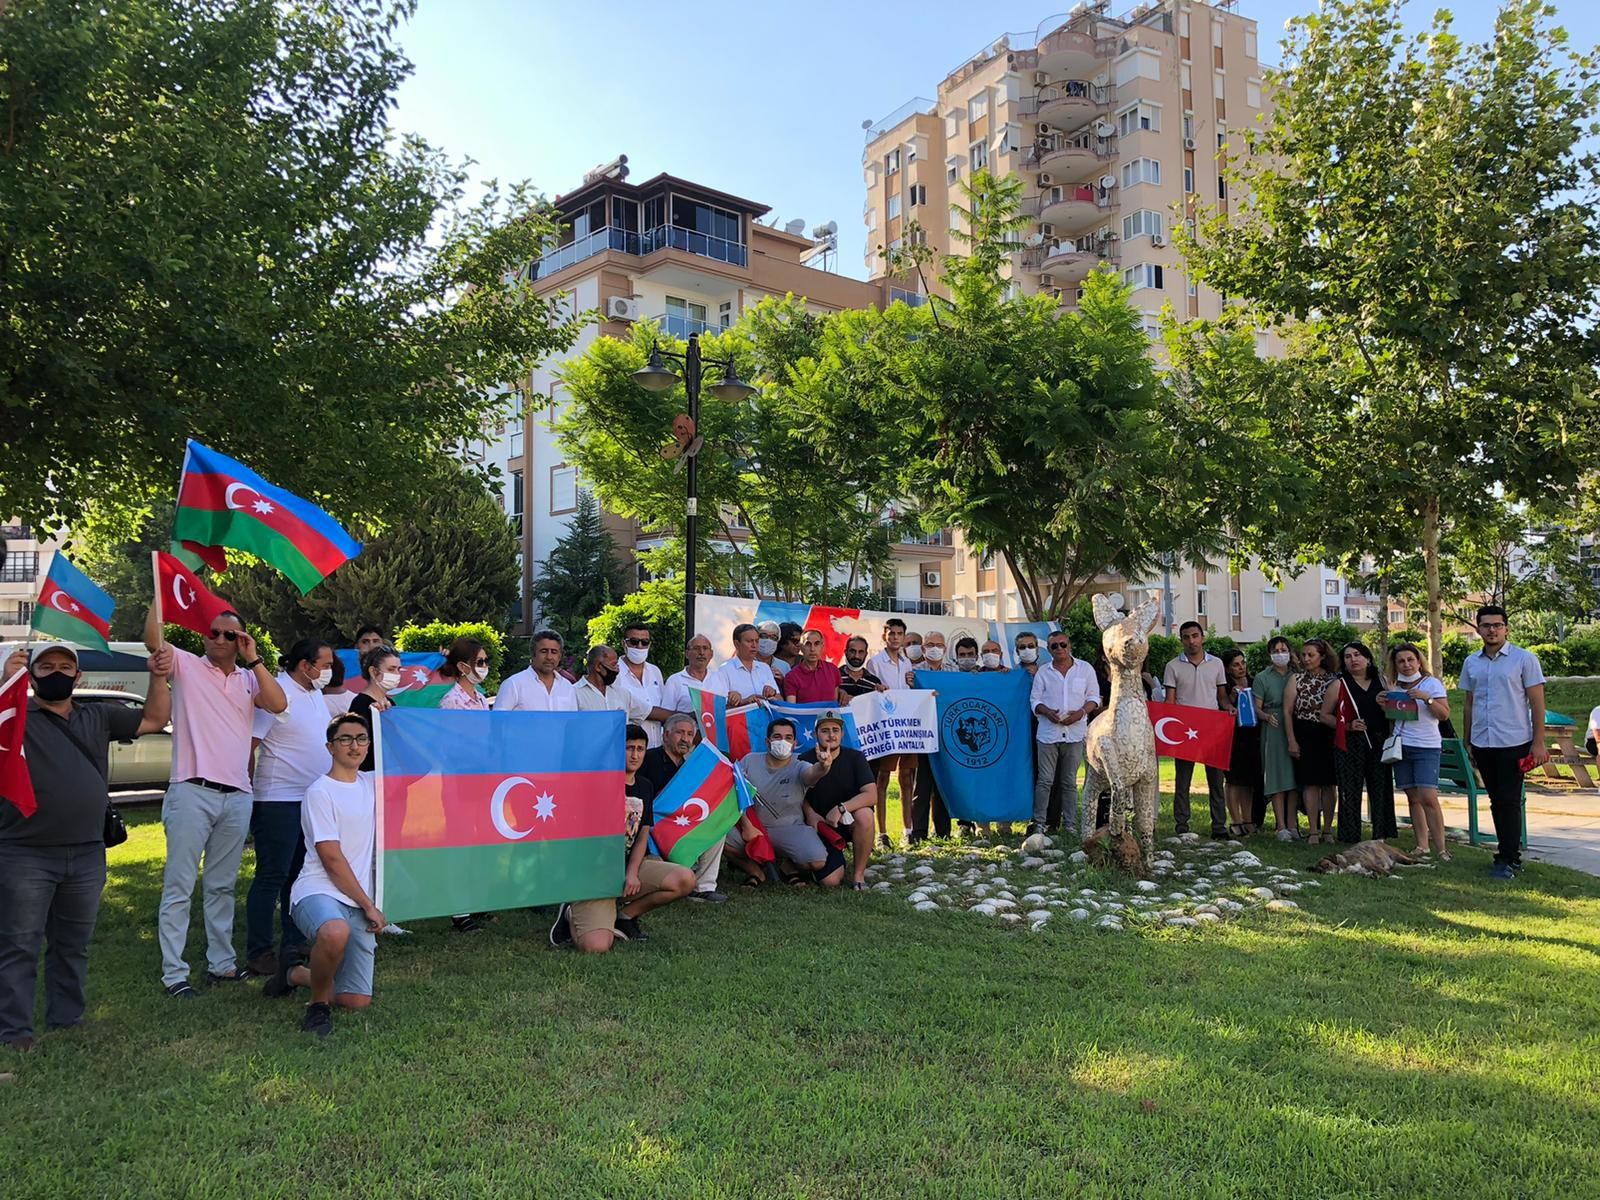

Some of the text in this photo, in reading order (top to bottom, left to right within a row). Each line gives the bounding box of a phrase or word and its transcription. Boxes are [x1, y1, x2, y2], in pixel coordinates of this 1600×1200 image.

[962, 701, 1004, 727] OCAKLARI
[857, 717, 921, 736] IRAK TÜRKMEN
[879, 731, 891, 741] VE
[894, 729, 934, 741] DAYANIŞMA
[897, 741, 925, 750] ANTALYA
[966, 757, 988, 766] 1912
